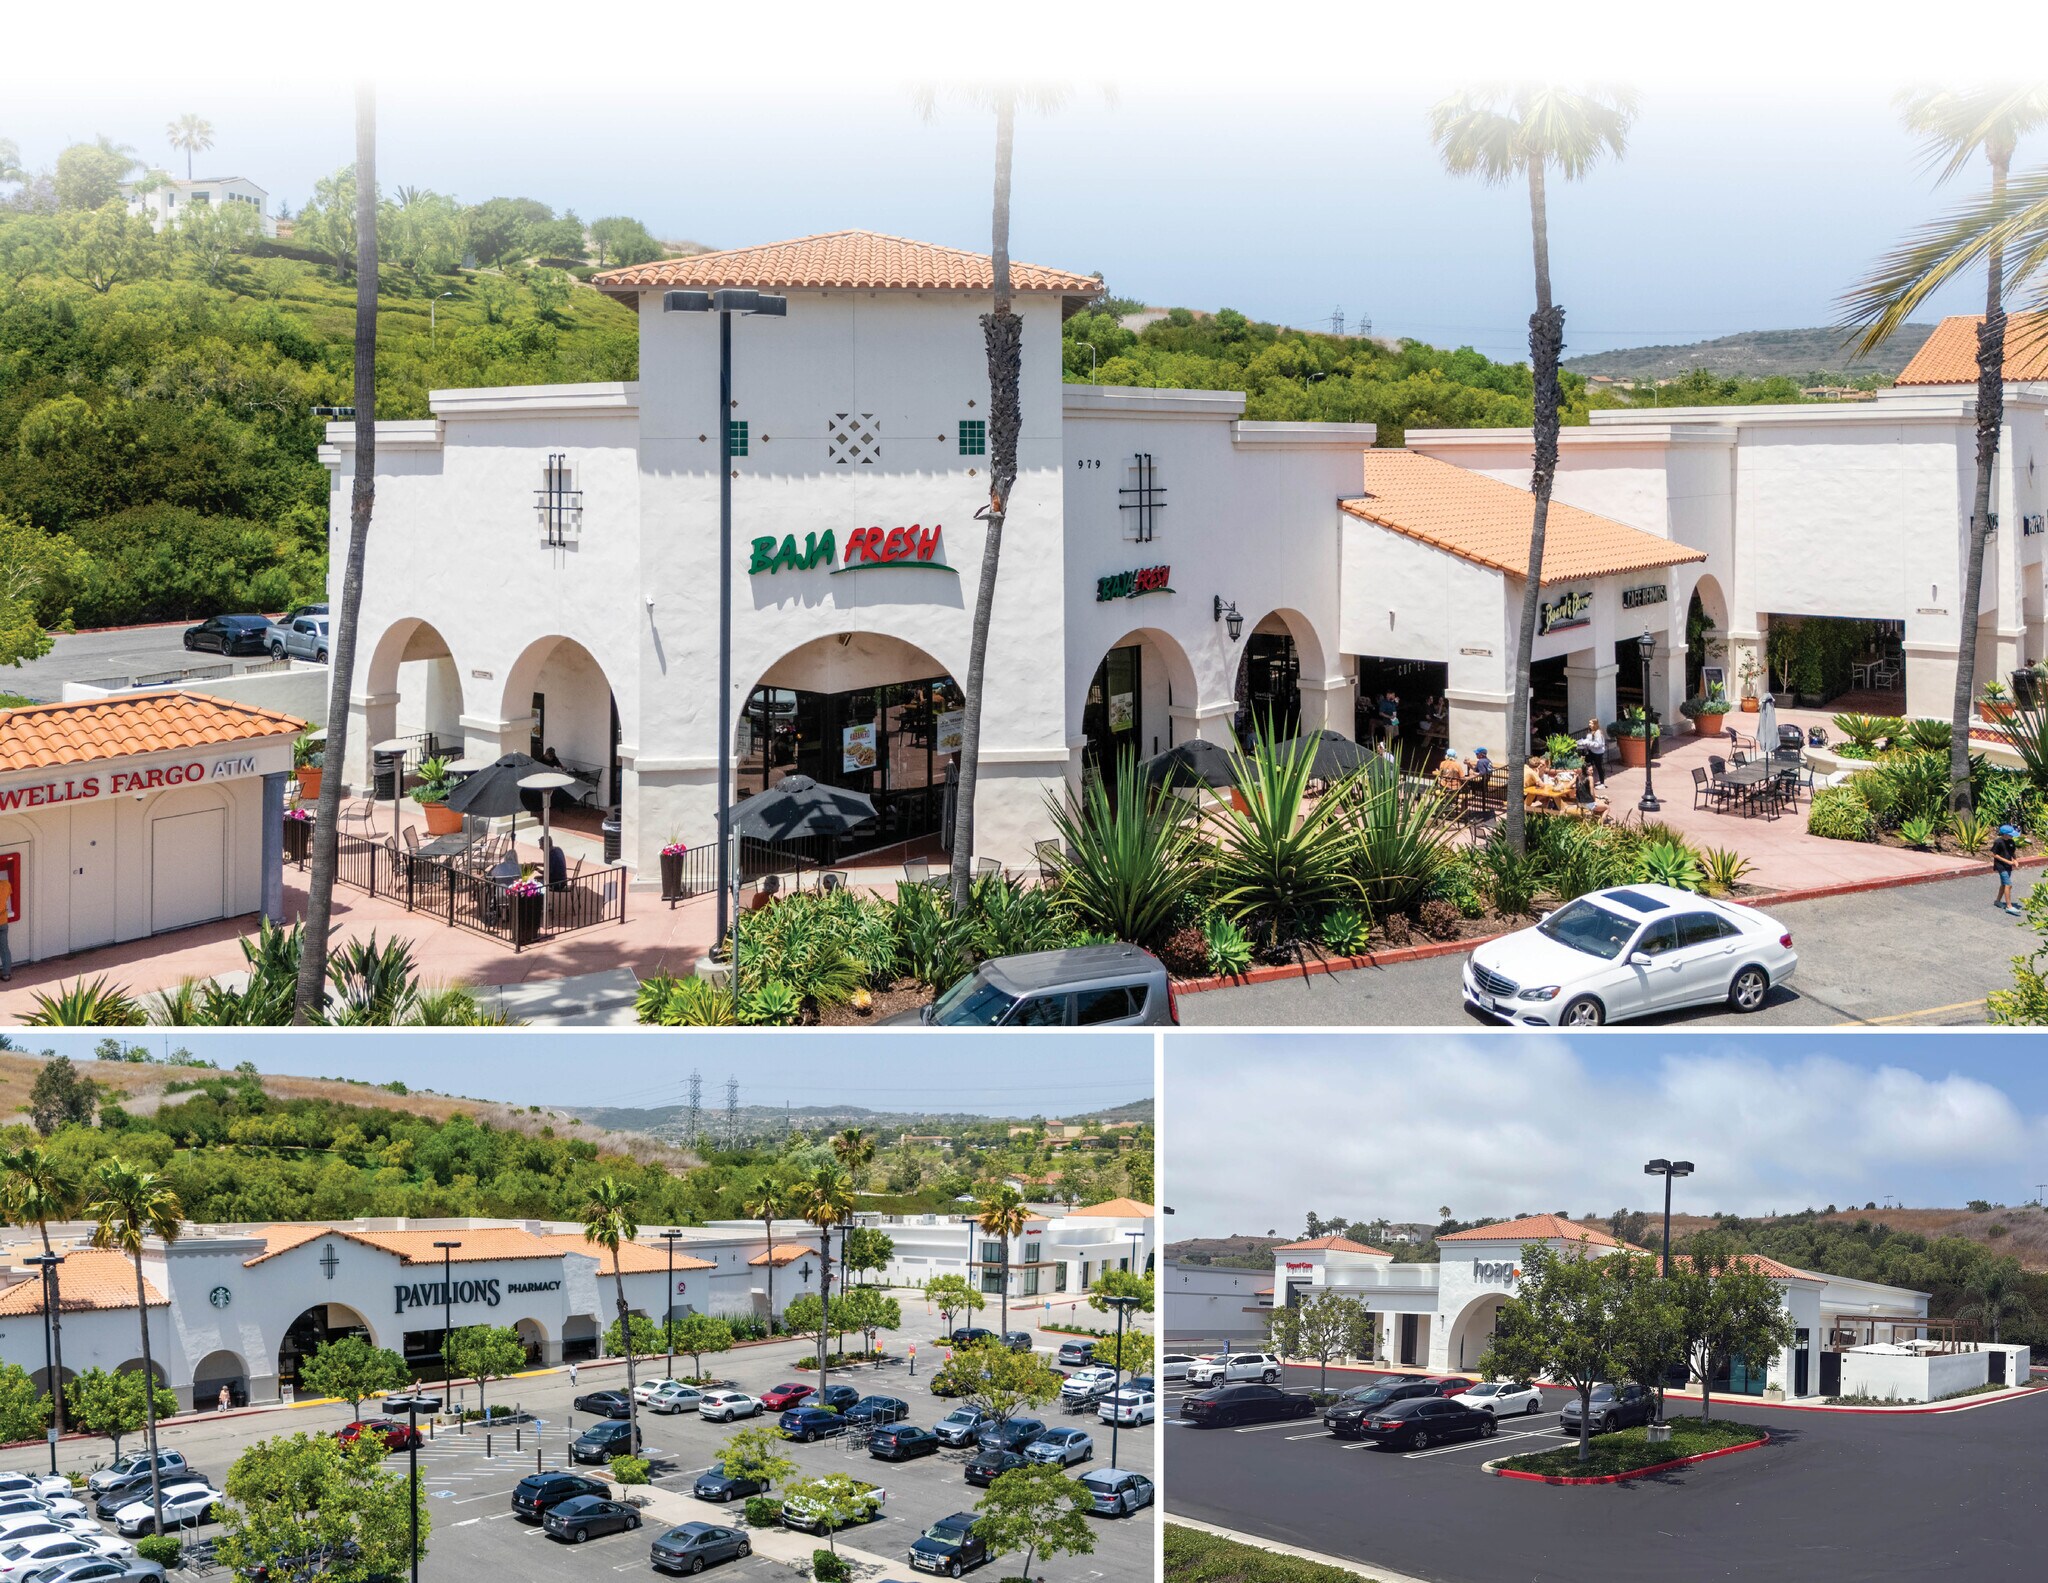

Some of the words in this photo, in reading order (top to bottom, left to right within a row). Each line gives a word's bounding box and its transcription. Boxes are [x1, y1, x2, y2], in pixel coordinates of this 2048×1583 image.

[1078, 459, 1101, 470] 979
[748, 528, 835, 575] BAJA
[844, 524, 942, 562] FRESH
[1098, 570, 1137, 602] BAJA
[1136, 565, 1170, 590] FRESH
[1627, 589, 1643, 608] CAFE
[1543, 597, 1567, 632] Board
[1572, 591, 1590, 619] Brew
[0, 778, 99, 811] WELLS
[111, 763, 205, 793] FARGO
[211, 757, 257, 778] ATM
[394, 1279, 501, 1314] PAVILIONS
[508, 1281, 561, 1293] PHARMACY
